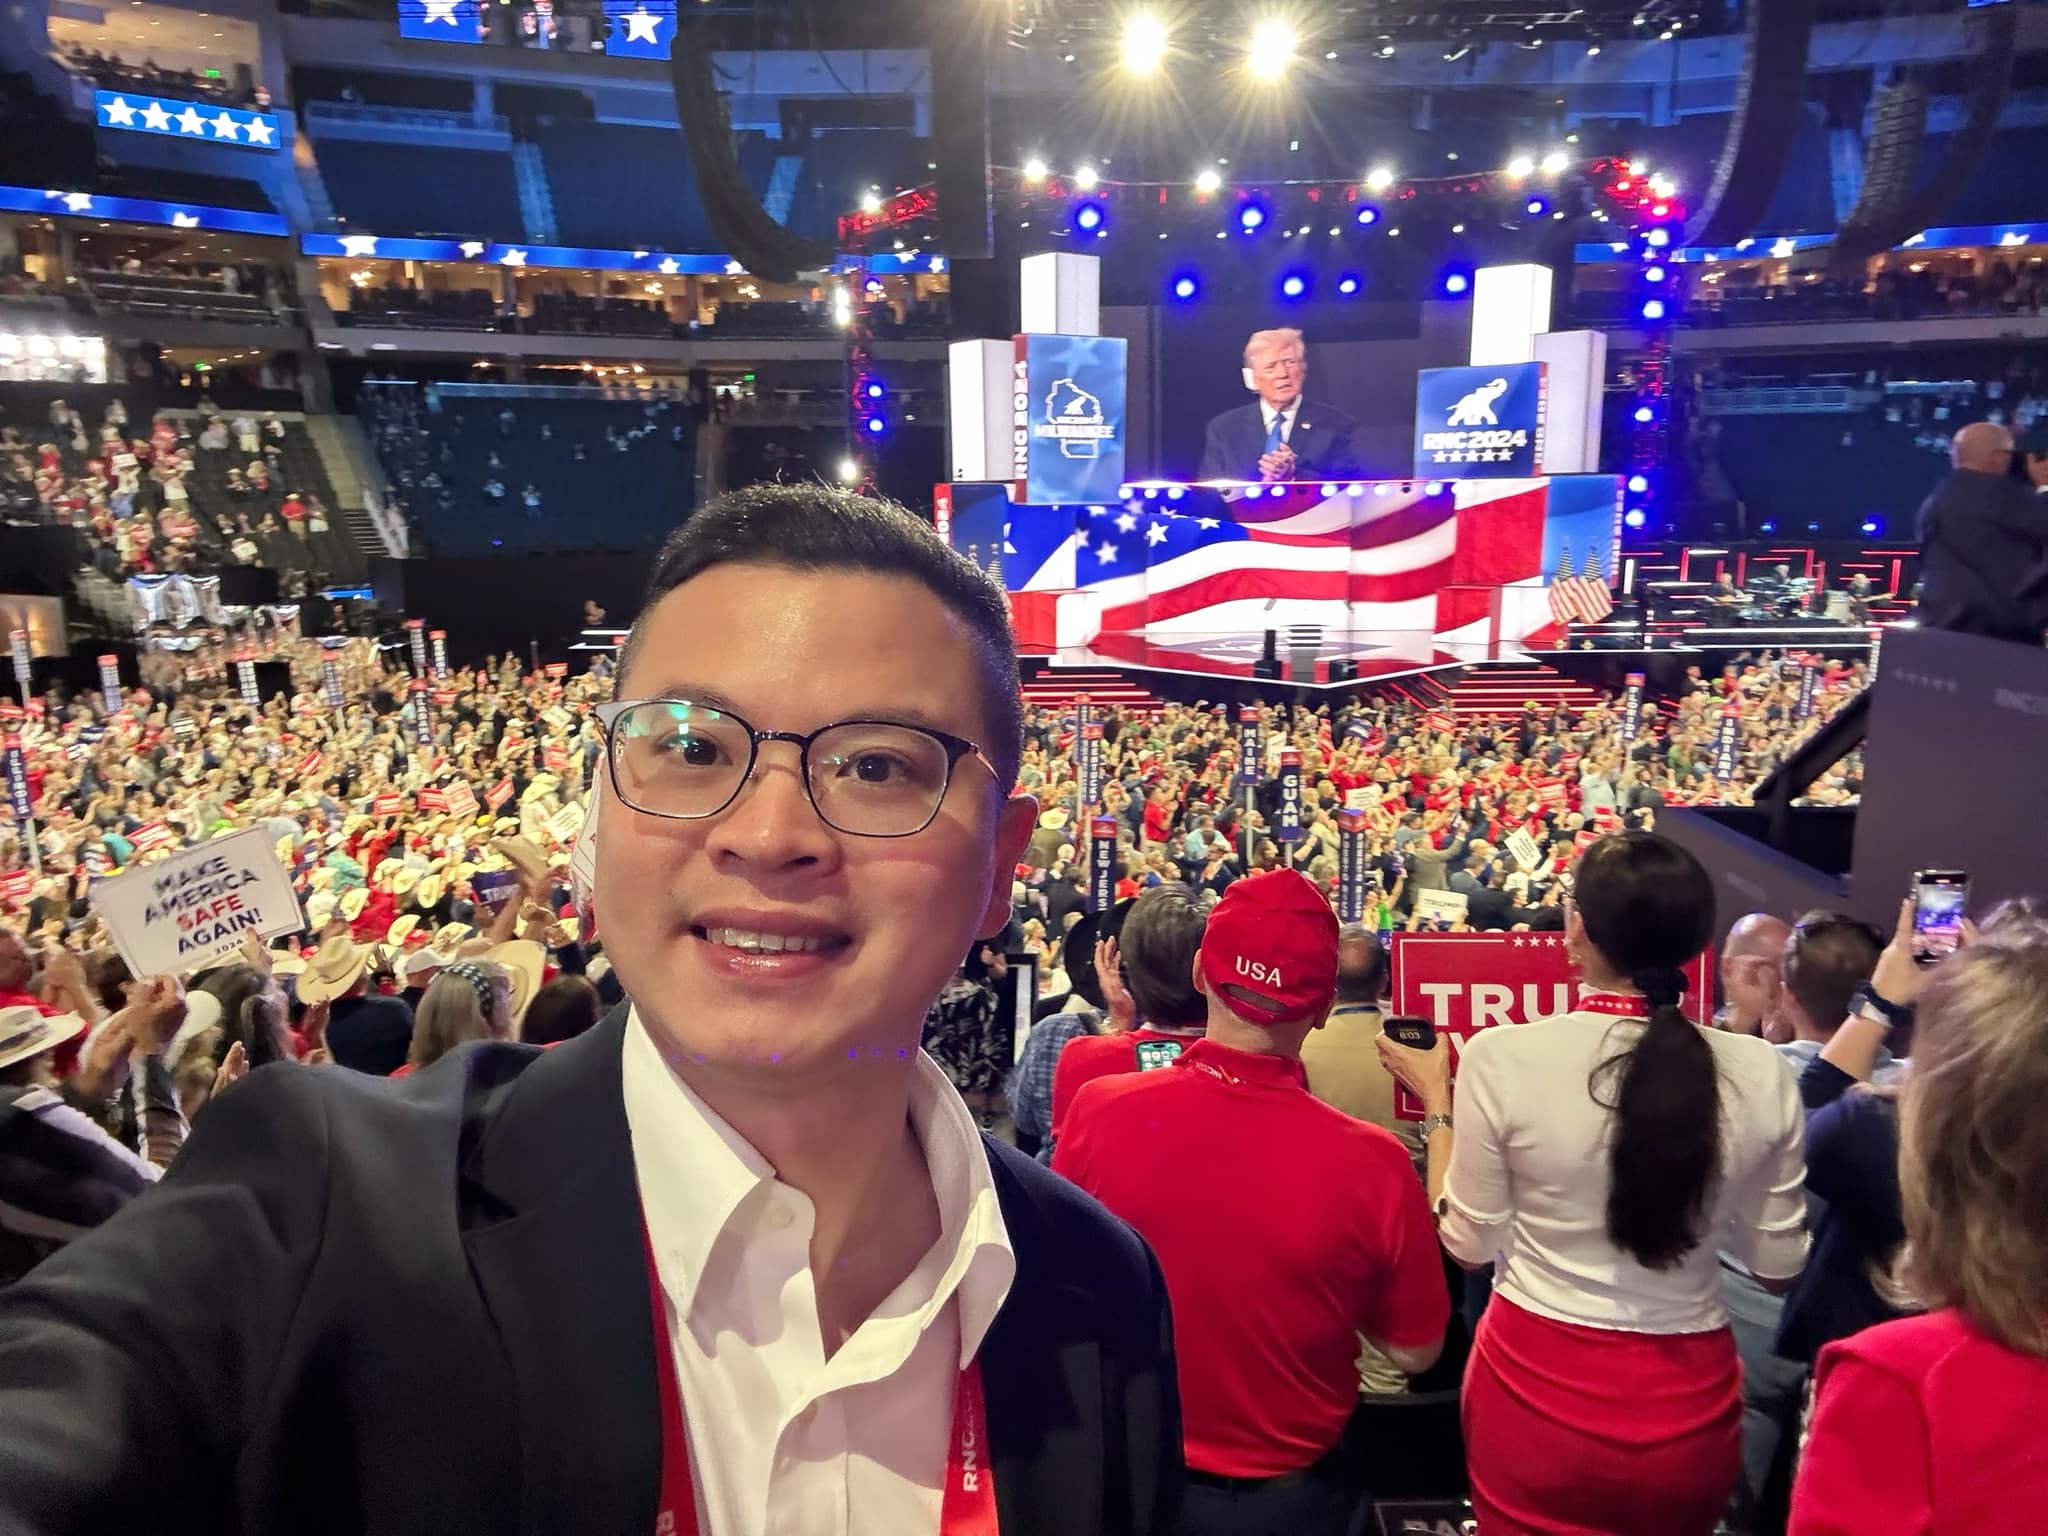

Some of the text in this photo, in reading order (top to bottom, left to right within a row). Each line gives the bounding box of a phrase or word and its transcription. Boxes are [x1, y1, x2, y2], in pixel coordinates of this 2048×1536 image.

[1089, 740, 1099, 802] KENTUCKY
[1243, 729, 1256, 775] MAINE
[1717, 718, 1735, 778] INDIANA
[10, 750, 31, 815] ILLINOIS
[1282, 774, 1298, 827] GUAM
[144, 868, 260, 928] AMERICA
[153, 855, 230, 894] MAKE
[1096, 840, 1111, 911] NEW JERS
[176, 893, 244, 931] SAFE
[178, 907, 263, 955] AGAIN!
[214, 938, 244, 955] 2024
[1236, 955, 1282, 987] USA
[1420, 983, 1575, 1027] TRU
[1399, 1031, 1421, 1040] 8:03
